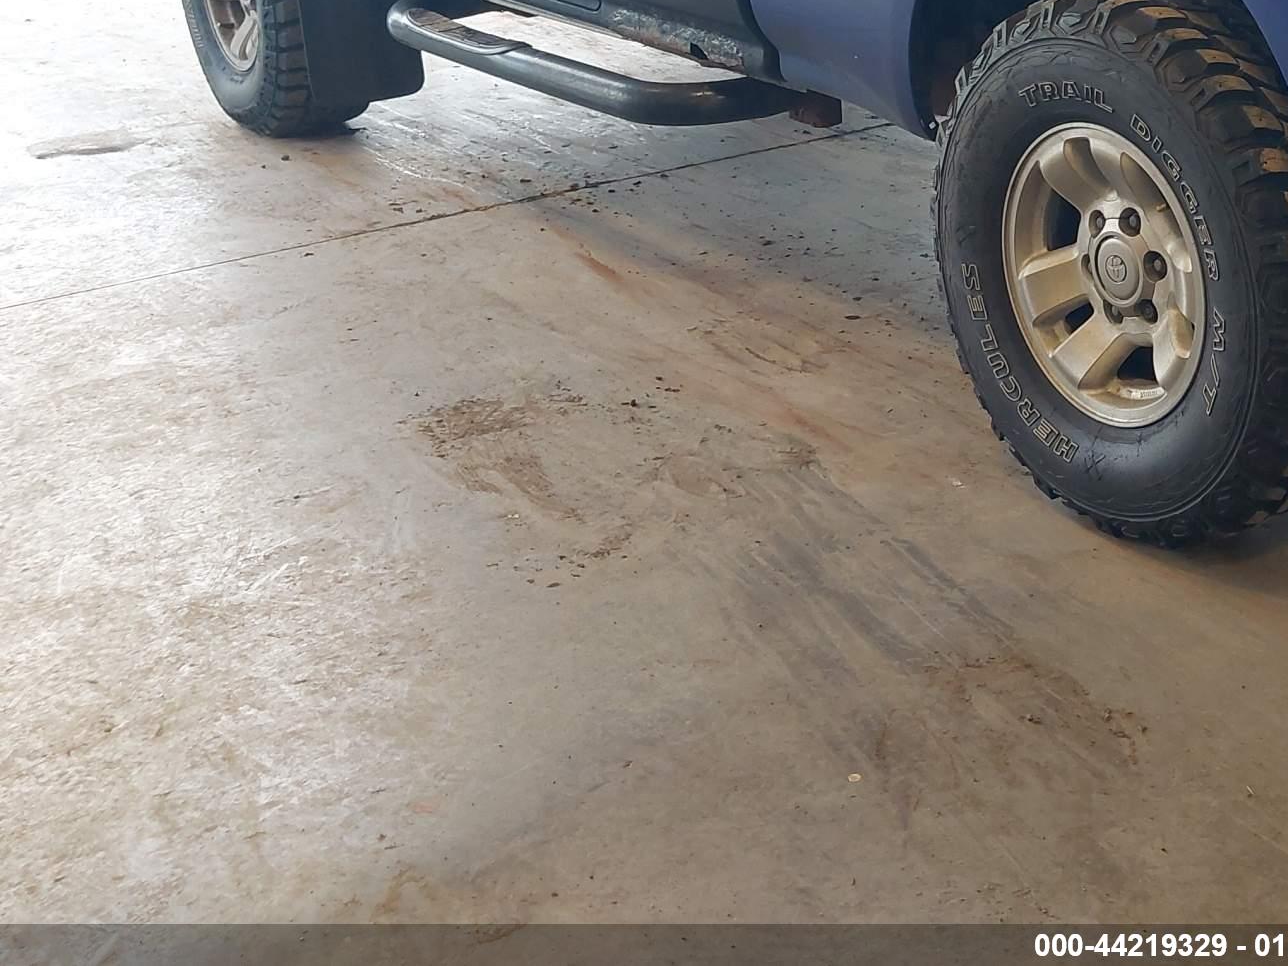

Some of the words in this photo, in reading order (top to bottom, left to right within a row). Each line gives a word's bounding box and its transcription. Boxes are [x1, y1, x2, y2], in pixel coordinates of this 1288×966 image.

[960, 262, 1080, 464] HERCULES
[1018, 80, 1114, 114] TRAIL
[1128, 113, 1221, 282] DIGGER
[1202, 305, 1226, 417] M/T
